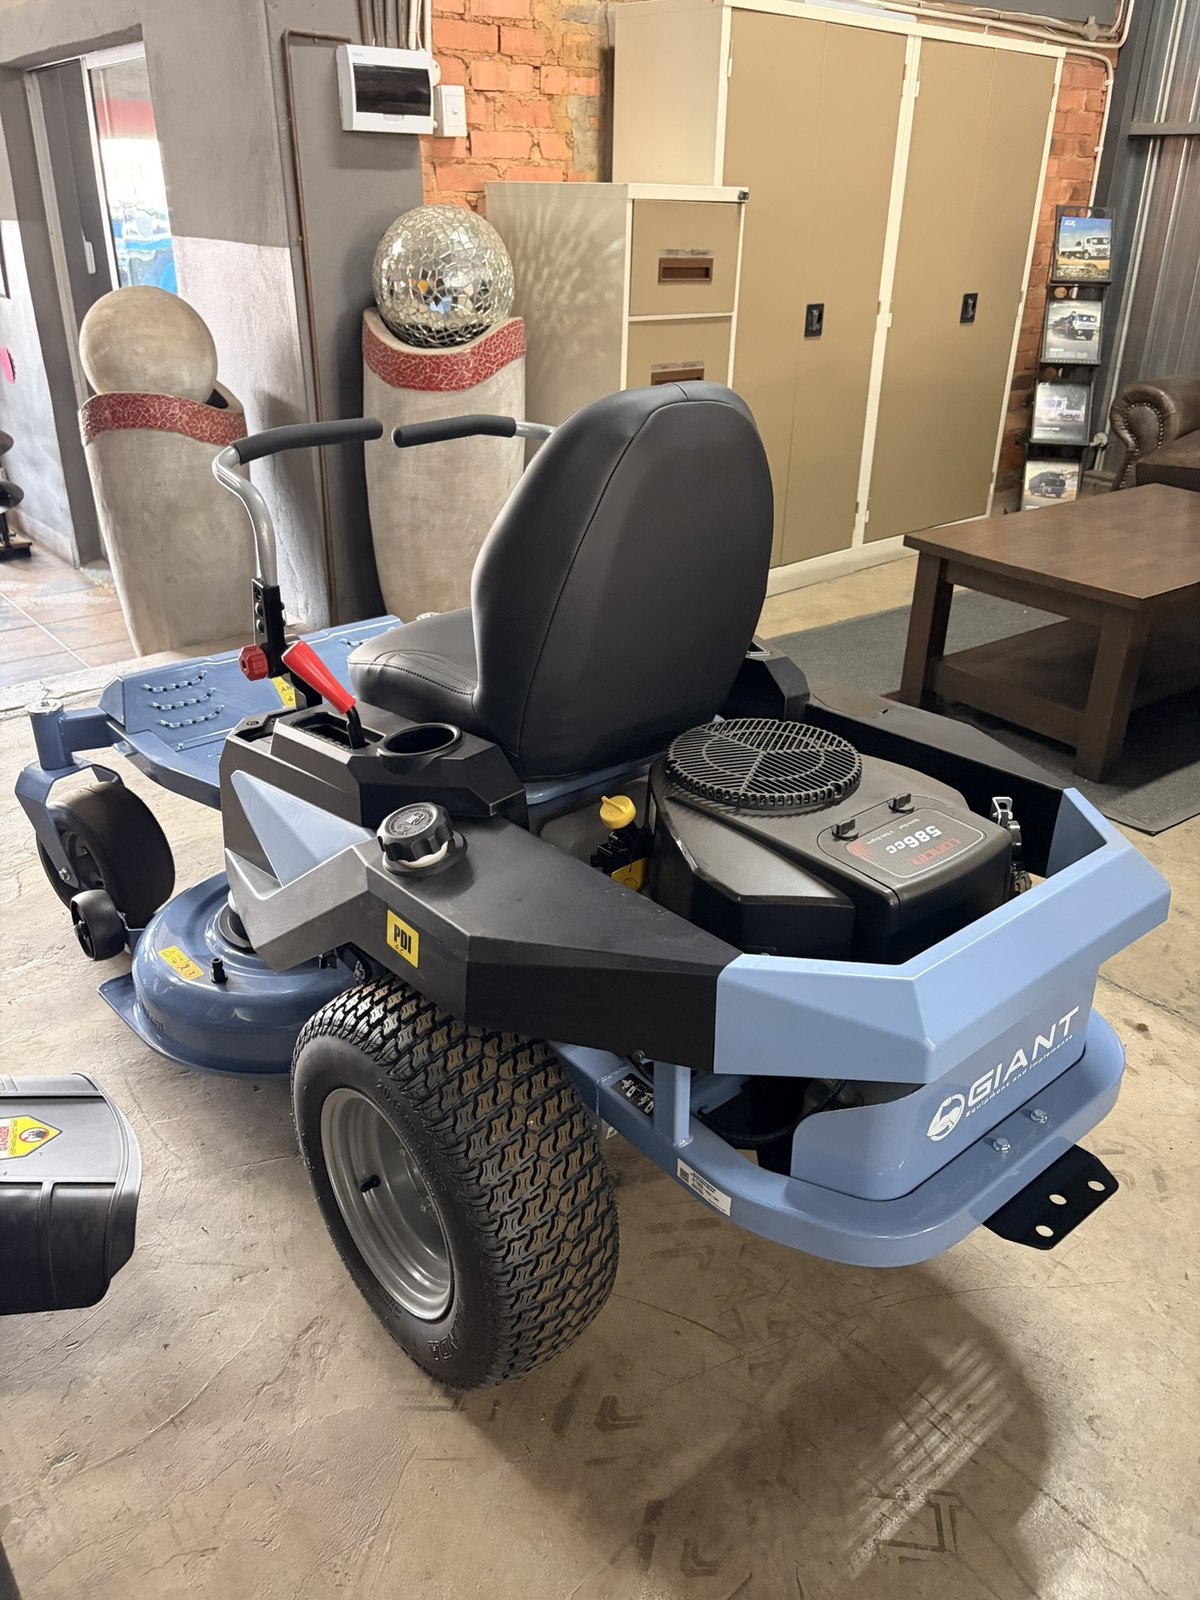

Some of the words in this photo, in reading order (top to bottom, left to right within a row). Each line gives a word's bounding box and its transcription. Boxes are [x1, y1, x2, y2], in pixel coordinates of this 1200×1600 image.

[885, 825, 943, 854] 586cc
[393, 923, 412, 955] PDI
[967, 1006, 1079, 1107] GIANT
